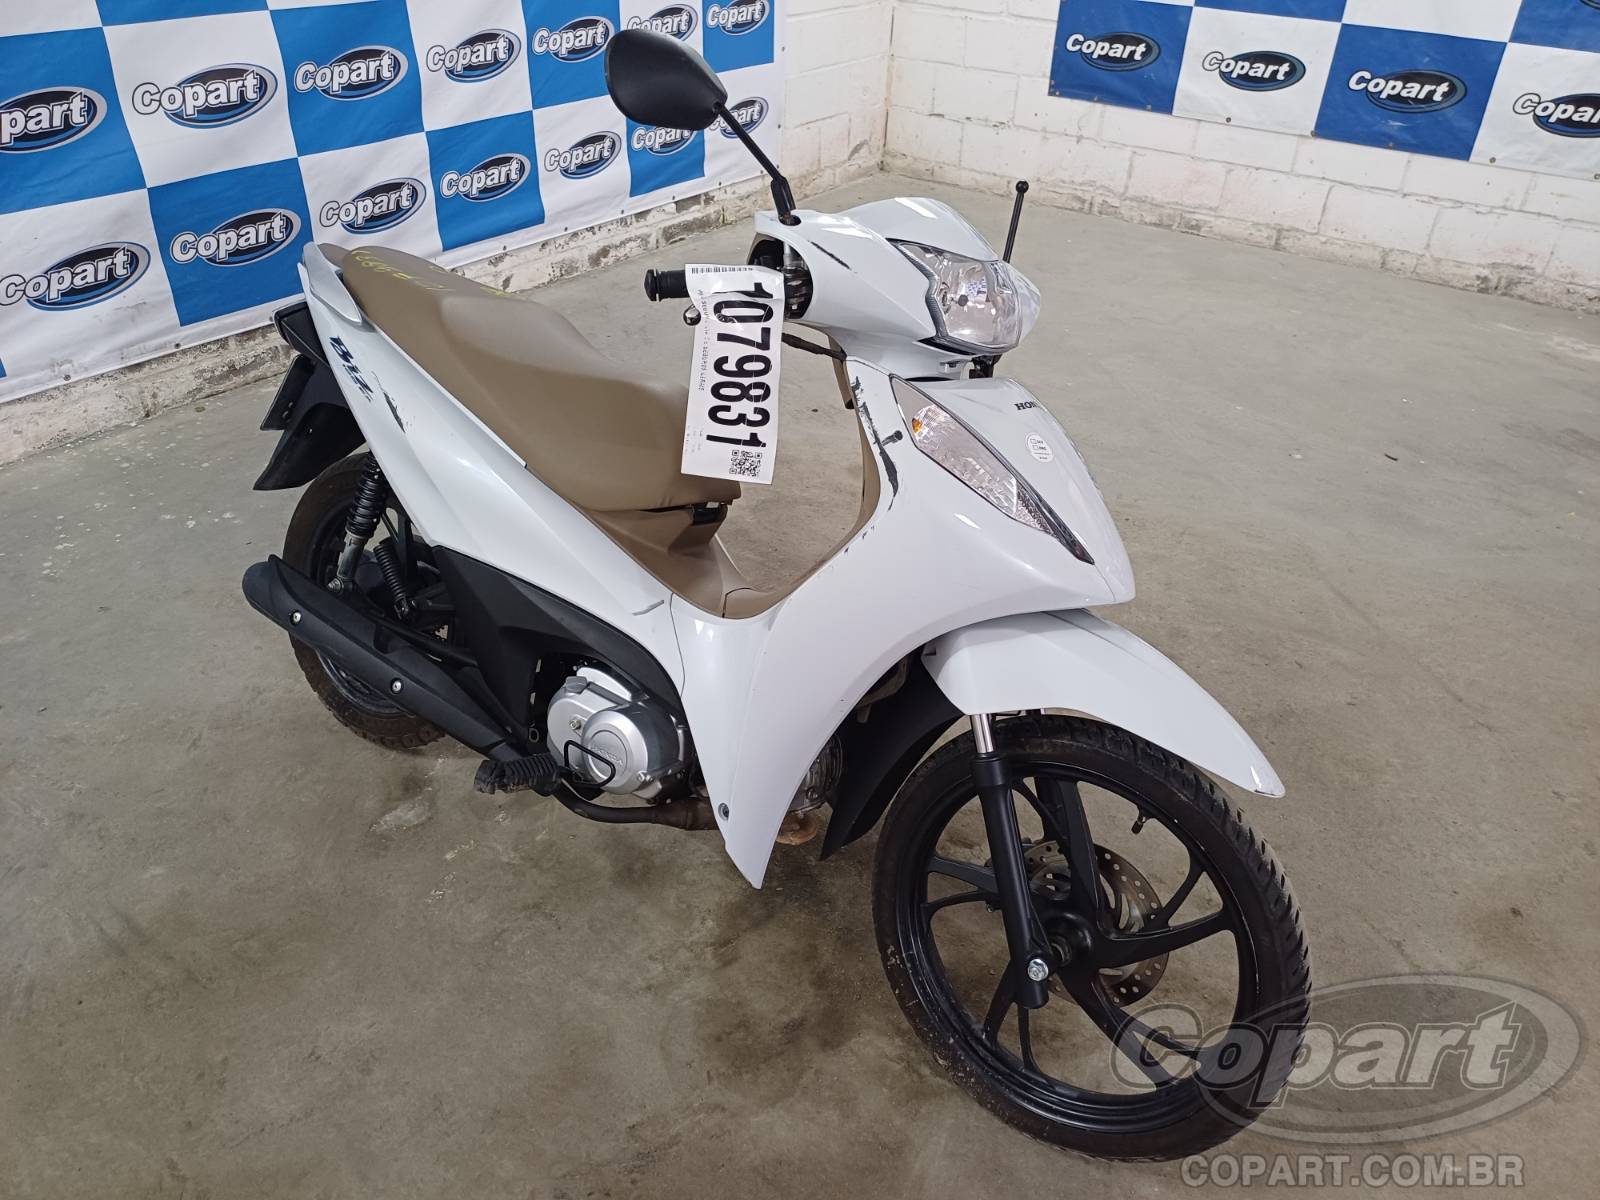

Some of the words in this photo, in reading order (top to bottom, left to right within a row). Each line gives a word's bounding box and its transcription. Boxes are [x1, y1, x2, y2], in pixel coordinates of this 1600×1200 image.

[706, 2, 763, 30] Copart
[427, 35, 509, 72] Copart
[532, 20, 605, 54] Copart
[1066, 33, 1147, 62] Copart
[294, 49, 395, 94] Copart
[1202, 51, 1290, 81] Copart
[133, 70, 260, 117] Copart
[1348, 70, 1450, 102] Copart
[0, 90, 87, 146] part
[1513, 93, 1600, 123] Copa
[544, 135, 613, 171] Copart
[441, 156, 521, 198] Copart
[319, 182, 412, 227] Copart
[171, 212, 288, 263] Copart
[0, 246, 131, 306] Copart
[706, 282, 774, 448] 1079831
